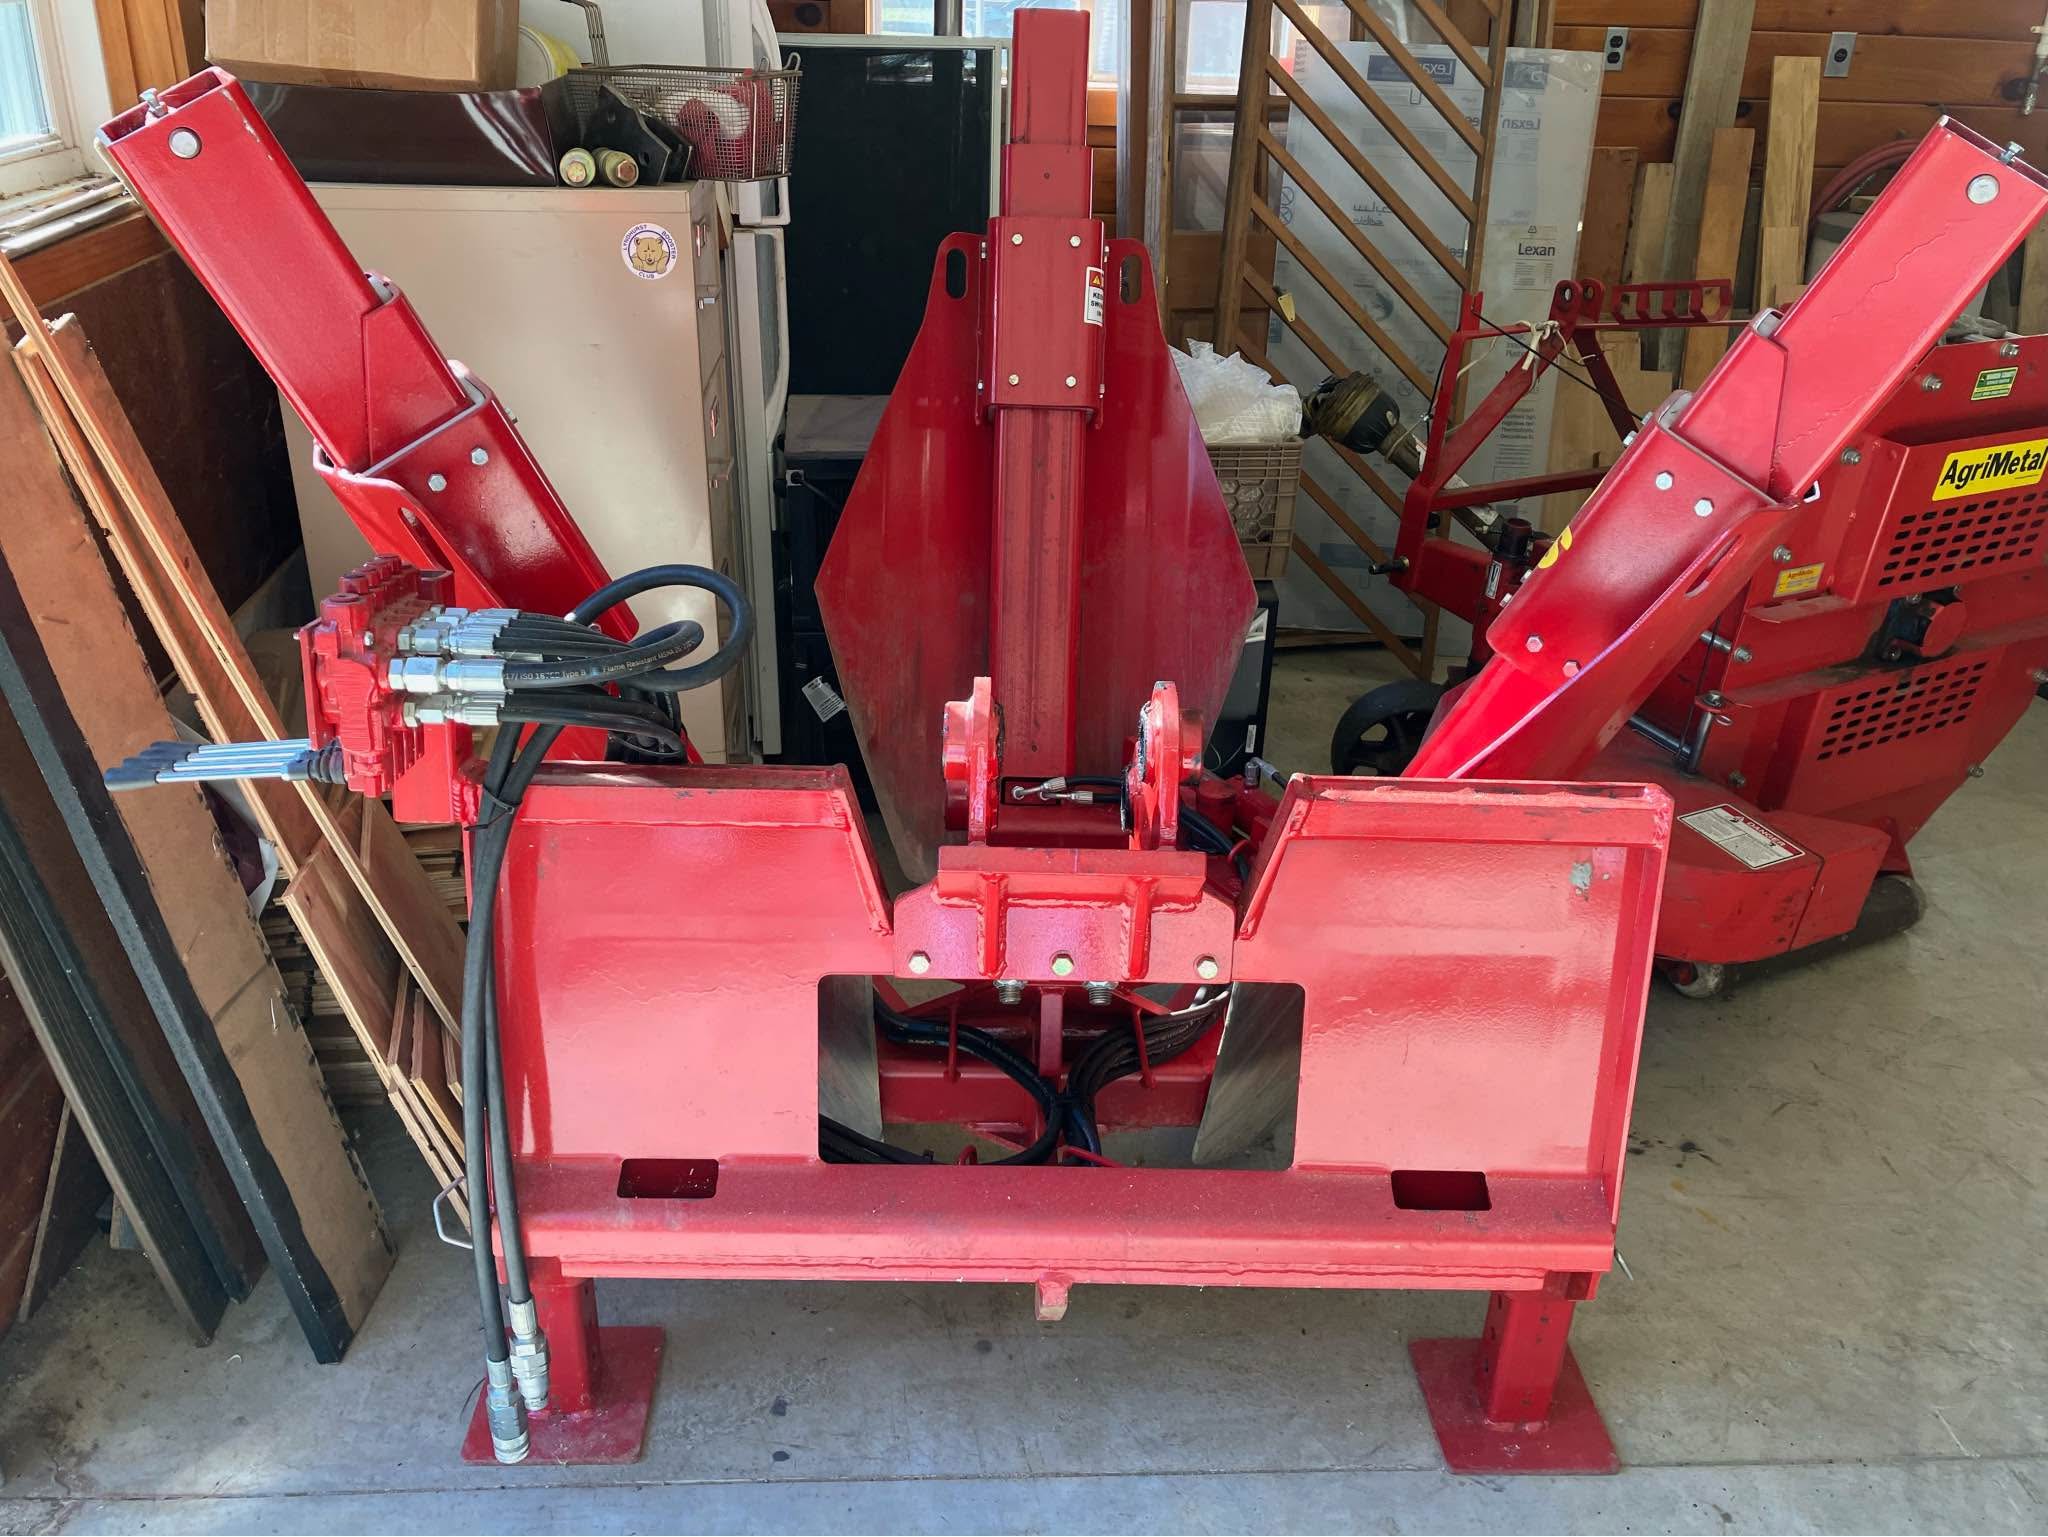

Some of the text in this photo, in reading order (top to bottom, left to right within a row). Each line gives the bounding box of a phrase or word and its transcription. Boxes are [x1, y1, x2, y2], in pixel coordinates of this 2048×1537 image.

[623, 224, 677, 260] LYNDHURST BOOSTER
[1518, 242, 1556, 257] Lexan
[638, 271, 655, 279] CLUB
[1940, 446, 2048, 490] AgriMetal
[602, 663, 626, 673] Flame
[626, 655, 658, 669] Resistant
[1746, 821, 1787, 847] DANGER
